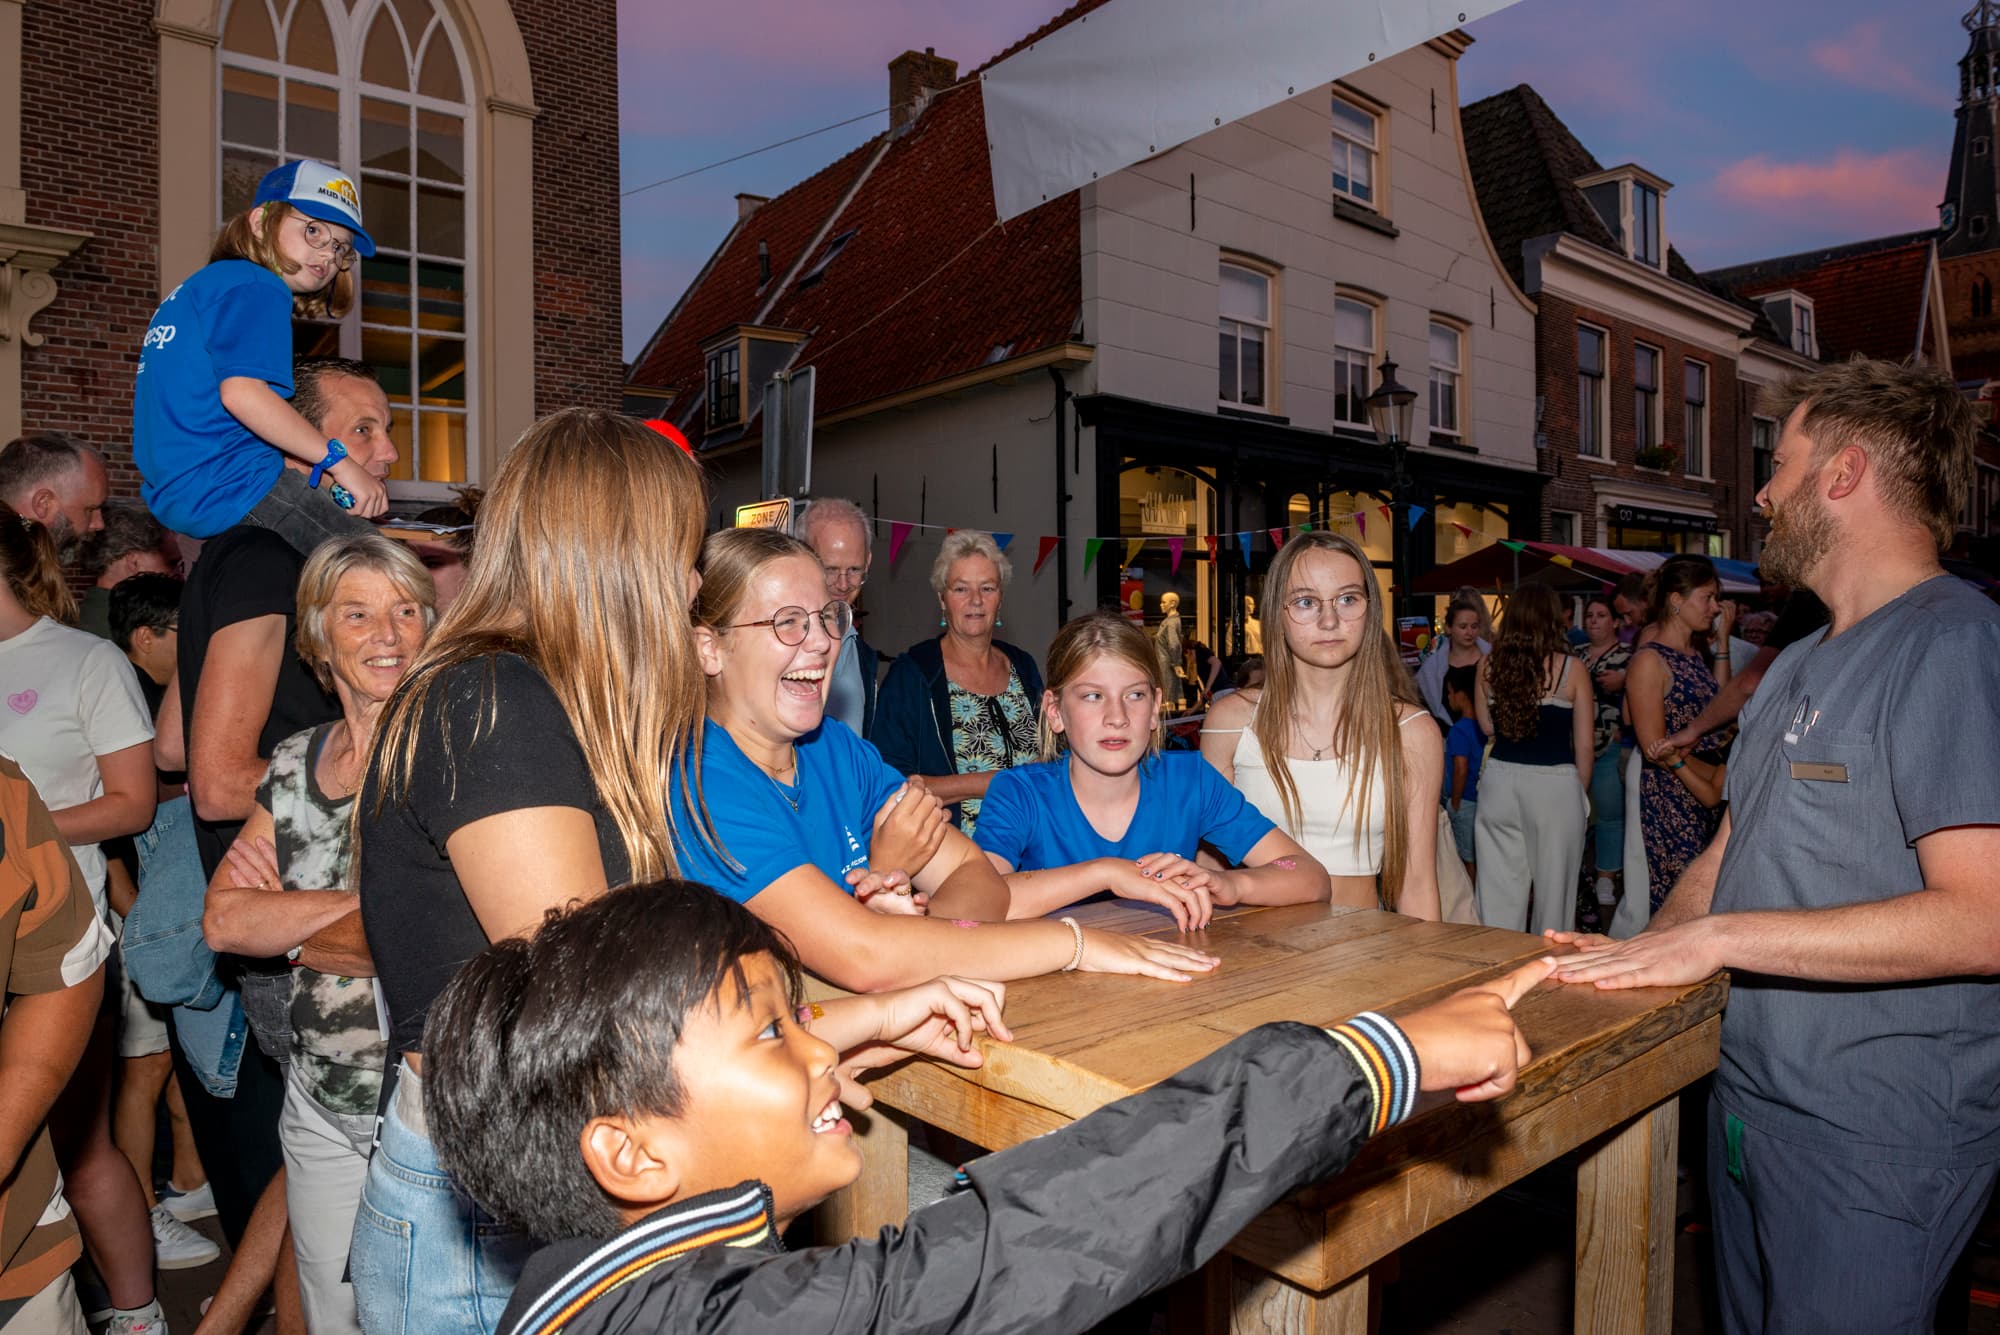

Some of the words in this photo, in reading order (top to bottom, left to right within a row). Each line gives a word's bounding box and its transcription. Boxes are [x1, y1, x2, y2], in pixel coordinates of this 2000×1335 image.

[318, 187, 339, 199] MUD
[143, 325, 176, 349] eesp
[751, 510, 775, 525] ZONE
